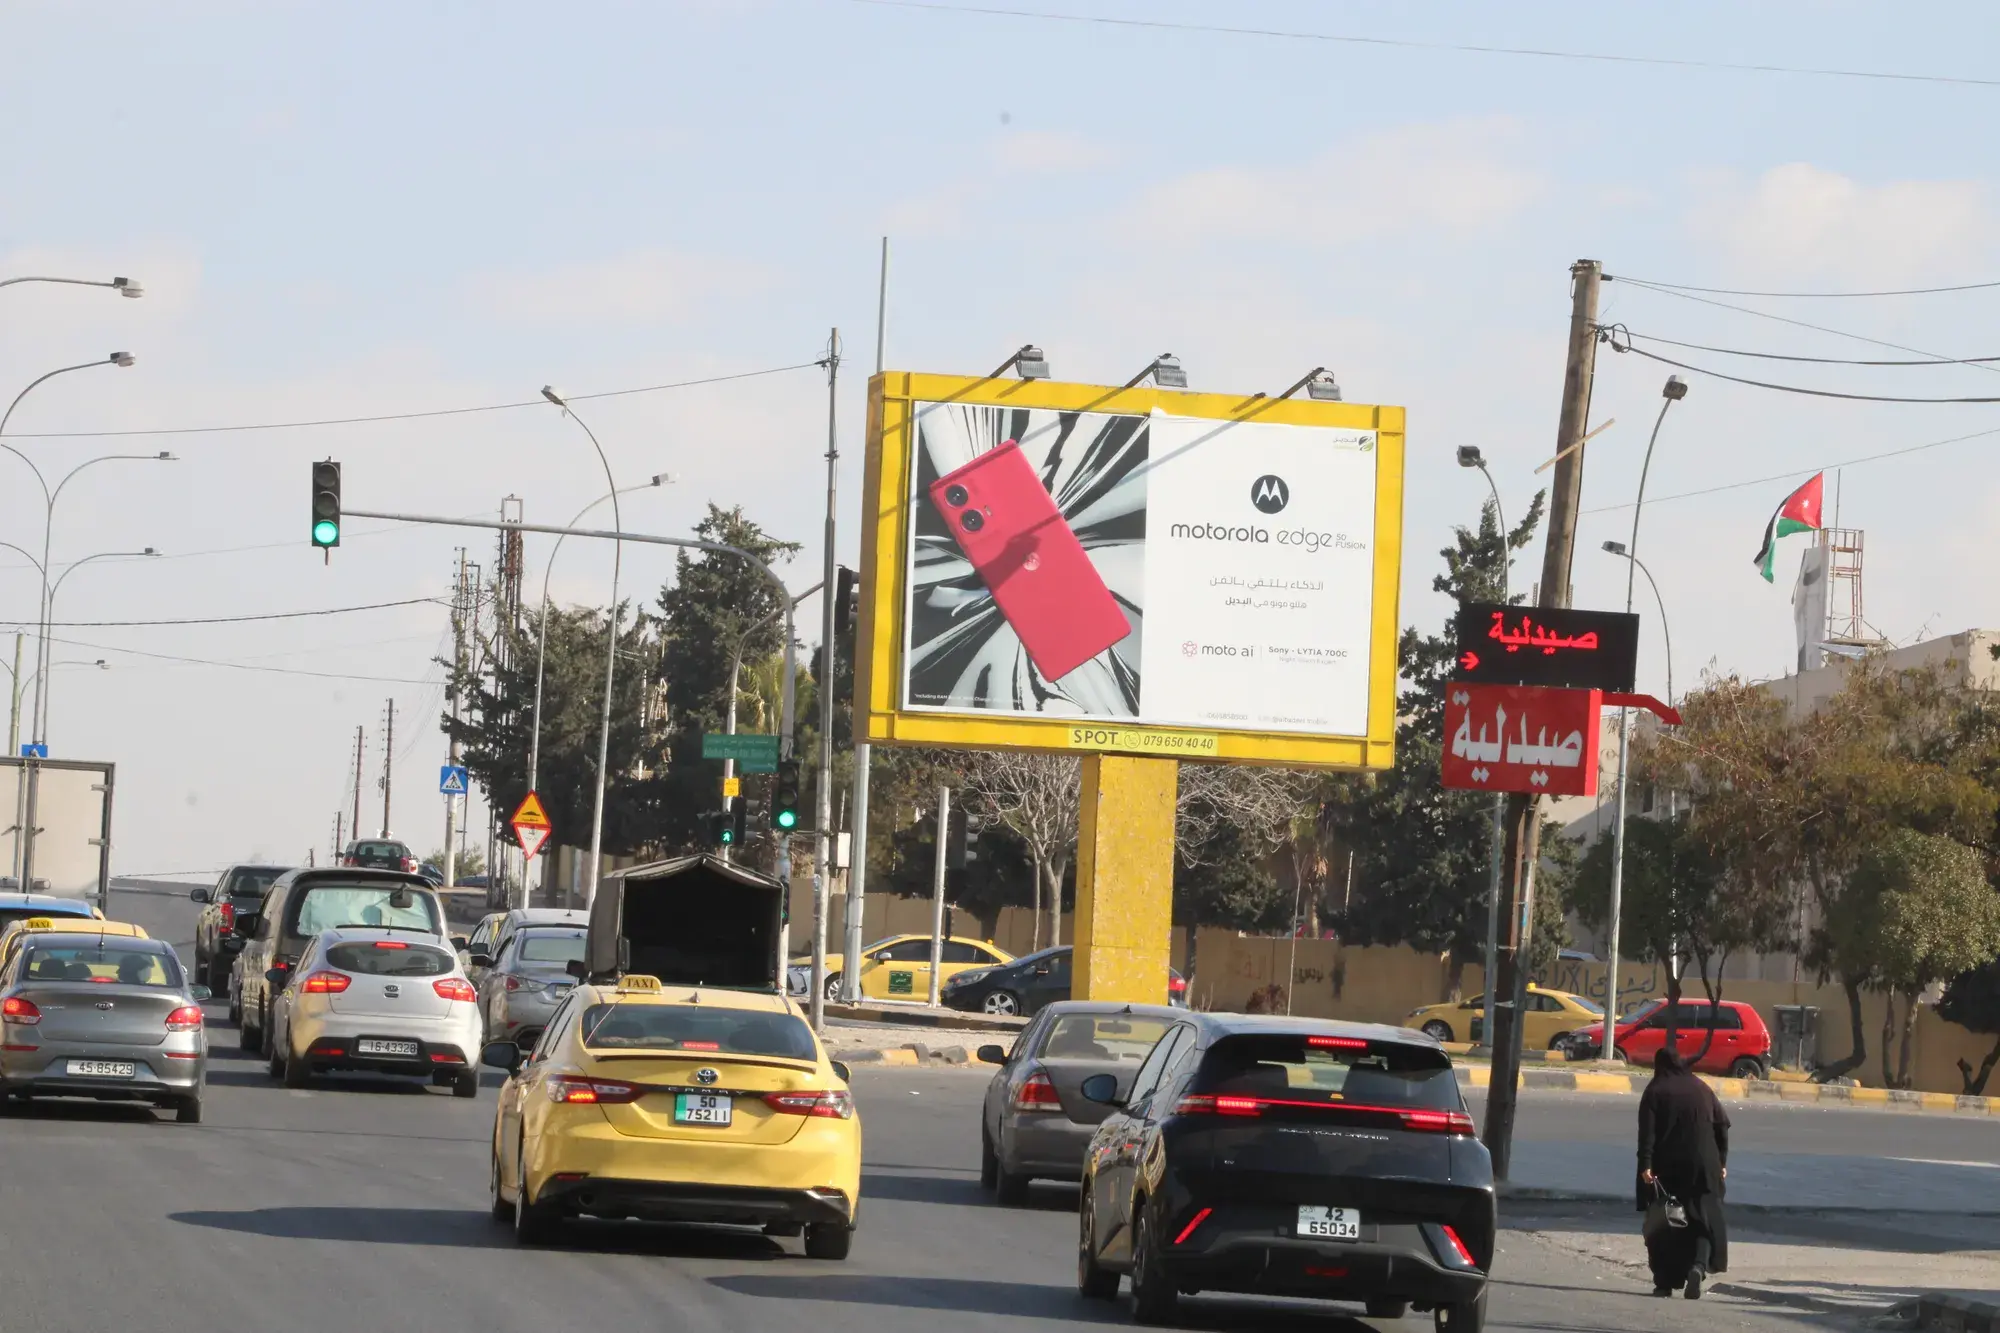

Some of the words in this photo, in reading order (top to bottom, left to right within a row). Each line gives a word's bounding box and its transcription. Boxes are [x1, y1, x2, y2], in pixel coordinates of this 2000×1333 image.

[1171, 522, 1269, 543] motorola
[1277, 527, 1333, 553] edge
[1336, 533, 1347, 541] 50
[1290, 580, 1323, 591] الذكاء
[1225, 596, 1251, 607] البديل
[1488, 611, 1598, 655] صيدلية
[1201, 644, 1236, 656] moto
[1241, 645, 1254, 657] ai
[1268, 646, 1289, 655] Sony
[1297, 648, 1322, 656] LYTIA
[1324, 649, 1348, 658] 700C
[1074, 729, 1119, 745] SPOT
[1144, 735, 1165, 746] 079
[1165, 736, 1183, 748] 650
[1185, 738, 1199, 748] 40
[1200, 738, 1213, 749] 40
[1451, 690, 1583, 787] صيدلية
[29, 920, 50, 928] TAXI
[626, 978, 654, 989] TAXI
[700, 1096, 717, 1108] 50
[687, 1108, 726, 1121] 75211
[1325, 1208, 1344, 1221] 42
[1310, 1221, 1357, 1237] 65034
